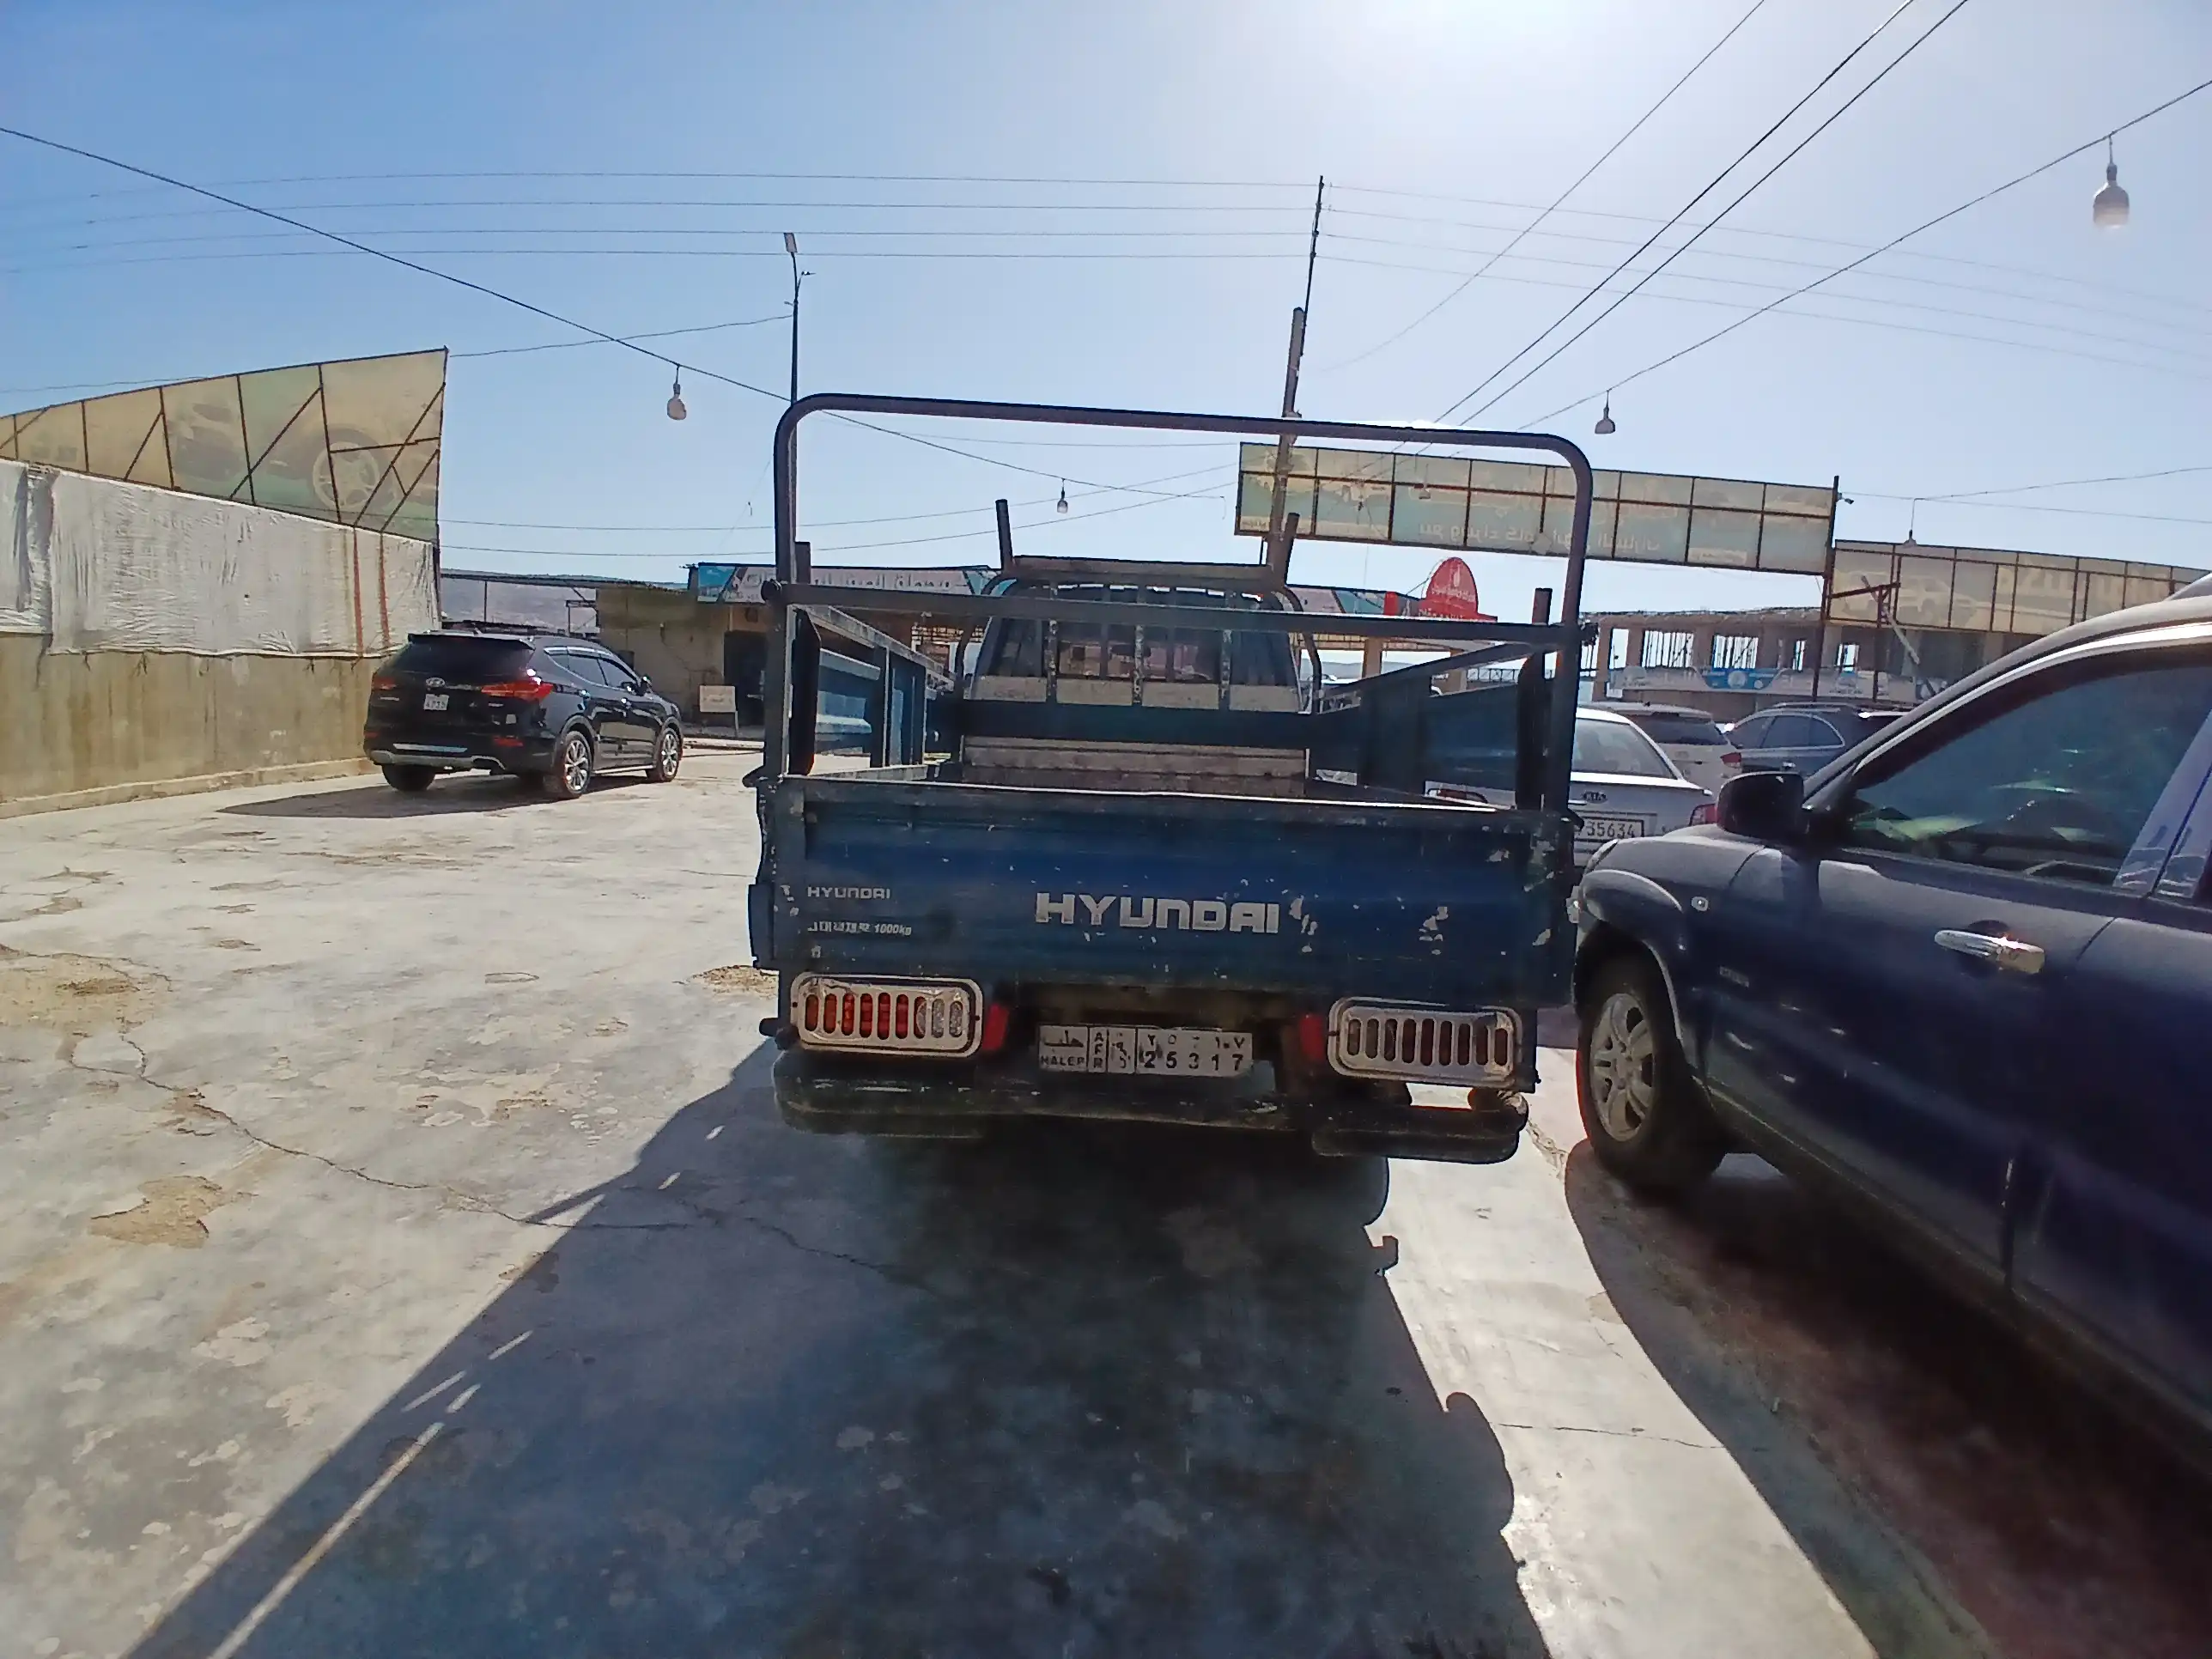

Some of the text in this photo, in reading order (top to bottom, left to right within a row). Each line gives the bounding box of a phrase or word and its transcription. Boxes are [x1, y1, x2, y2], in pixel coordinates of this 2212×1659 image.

[807, 885, 890, 899] HYUNDAI
[1035, 891, 1280, 934] HYUNDAI
[874, 923, 912, 936] 1000kg
[1144, 1050, 1244, 1072] 25317
